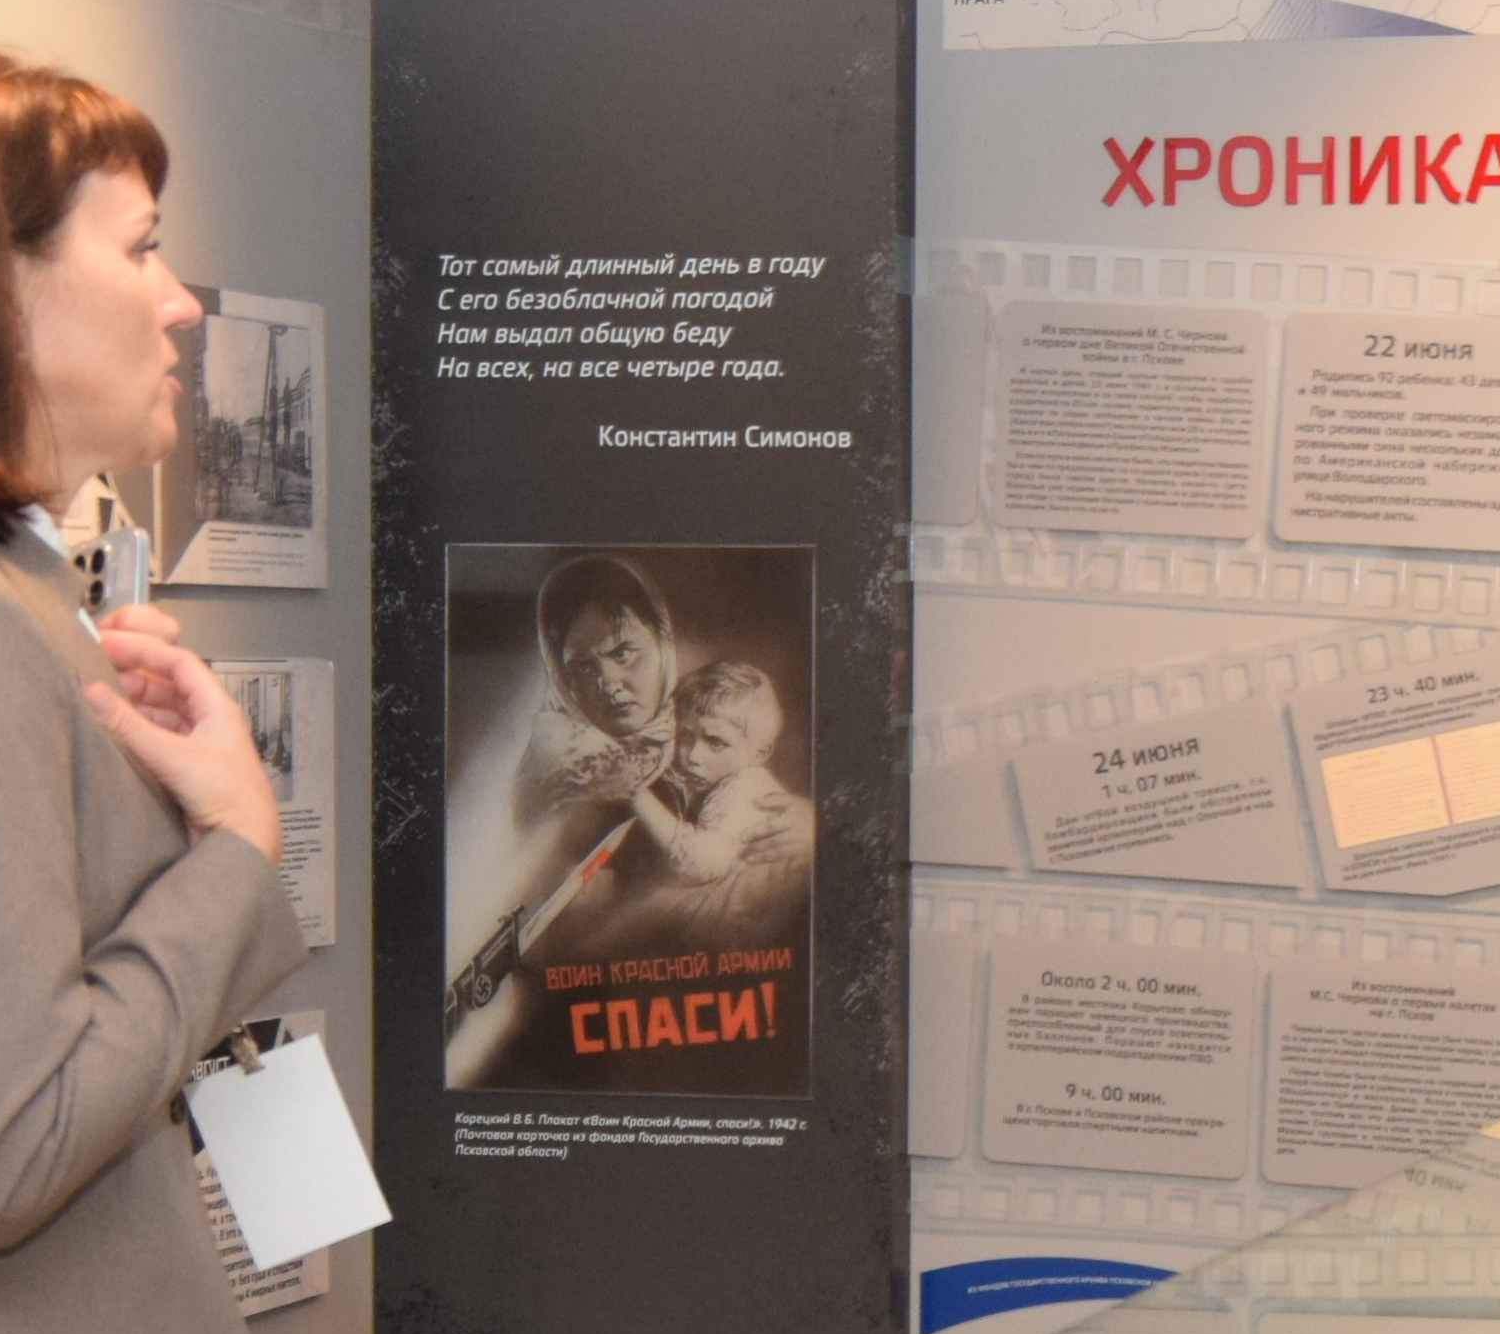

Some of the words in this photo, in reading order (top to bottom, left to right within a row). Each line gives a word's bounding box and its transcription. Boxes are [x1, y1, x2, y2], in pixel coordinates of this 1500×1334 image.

[439, 255, 476, 276] Тот
[483, 255, 560, 276] самый
[565, 254, 674, 278] длинный
[679, 256, 740, 278] день
[748, 257, 760, 274] в
[769, 257, 826, 278] году
[438, 288, 454, 310] С
[459, 293, 497, 310] его
[506, 288, 665, 310] безоблачной
[672, 288, 774, 312] погодой
[437, 323, 487, 345] Нам
[495, 327, 573, 345] выдал
[580, 322, 664, 347] общую
[672, 321, 732, 347] беду
[1364, 335, 1396, 357] 22
[1404, 342, 1474, 360] июня
[437, 357, 469, 378] На
[477, 361, 535, 380] всех,
[543, 360, 573, 378] на
[580, 360, 620, 378] все
[627, 359, 714, 382] четыре
[722, 360, 785, 380] года.
[598, 426, 737, 448] Константин
[744, 426, 852, 449] Симонов
[1092, 747, 1126, 775] 24
[1131, 737, 1200, 767] июня
[545, 966, 602, 991] ВОИН
[610, 953, 710, 983] КРАСНОЙ
[716, 947, 792, 976] АРМИИ
[1041, 971, 1096, 990] Около
[1101, 976, 1111, 990] 2
[1137, 978, 1159, 994] 00
[1163, 982, 1202, 996] мин.
[570, 982, 777, 1055] СПАСИ!
[455, 1112, 510, 1125] Корецкий
[539, 1114, 579, 1127] Плакат
[583, 1115, 619, 1127] «Воин
[622, 1116, 670, 1128] Красной
[673, 1117, 712, 1129] Армии,
[769, 1118, 797, 1130] 1942
